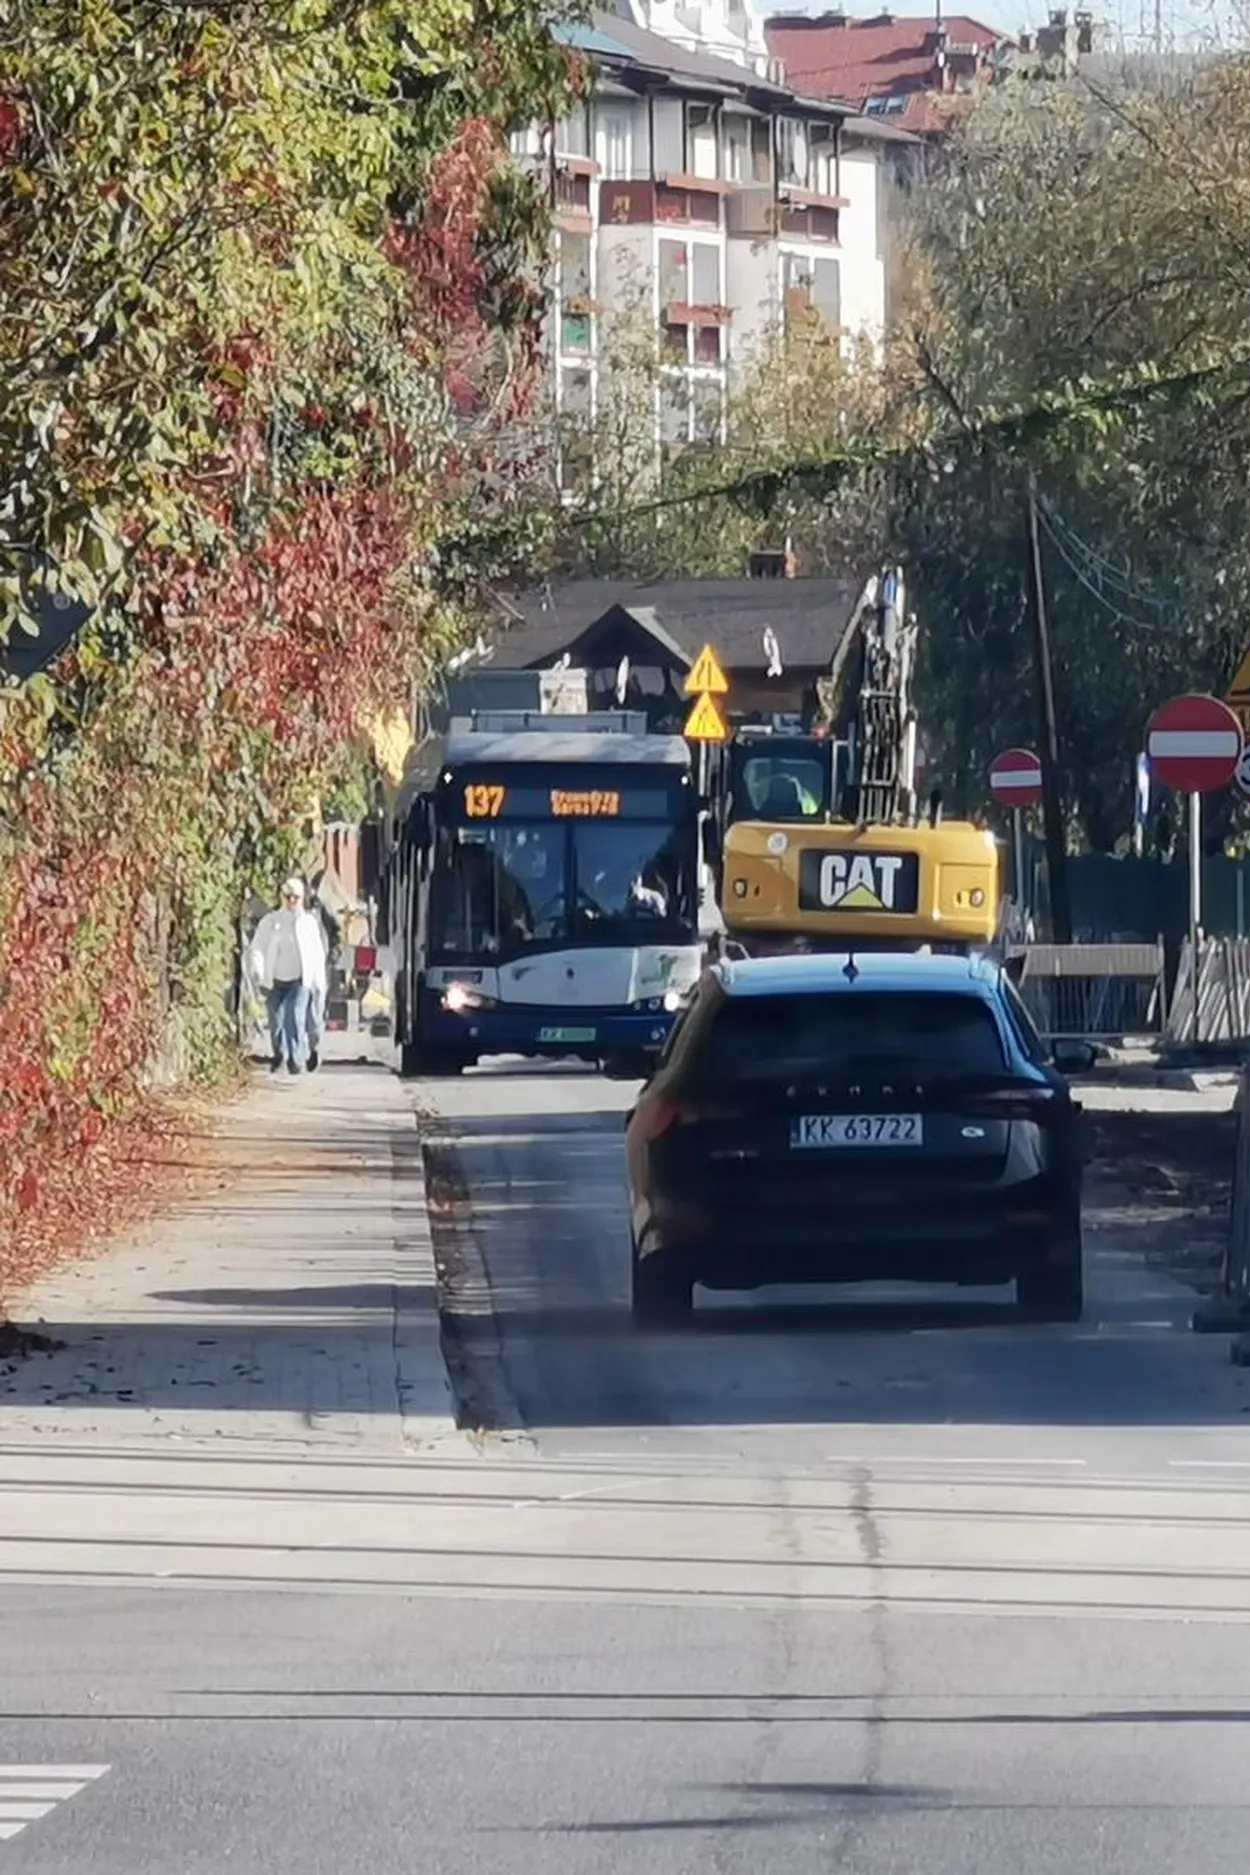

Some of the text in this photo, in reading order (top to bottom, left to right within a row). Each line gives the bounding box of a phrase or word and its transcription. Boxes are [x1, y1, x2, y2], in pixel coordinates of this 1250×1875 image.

[464, 784, 505, 817] 137
[820, 855, 903, 909] CAT
[804, 1118, 917, 1142] KK 63722
